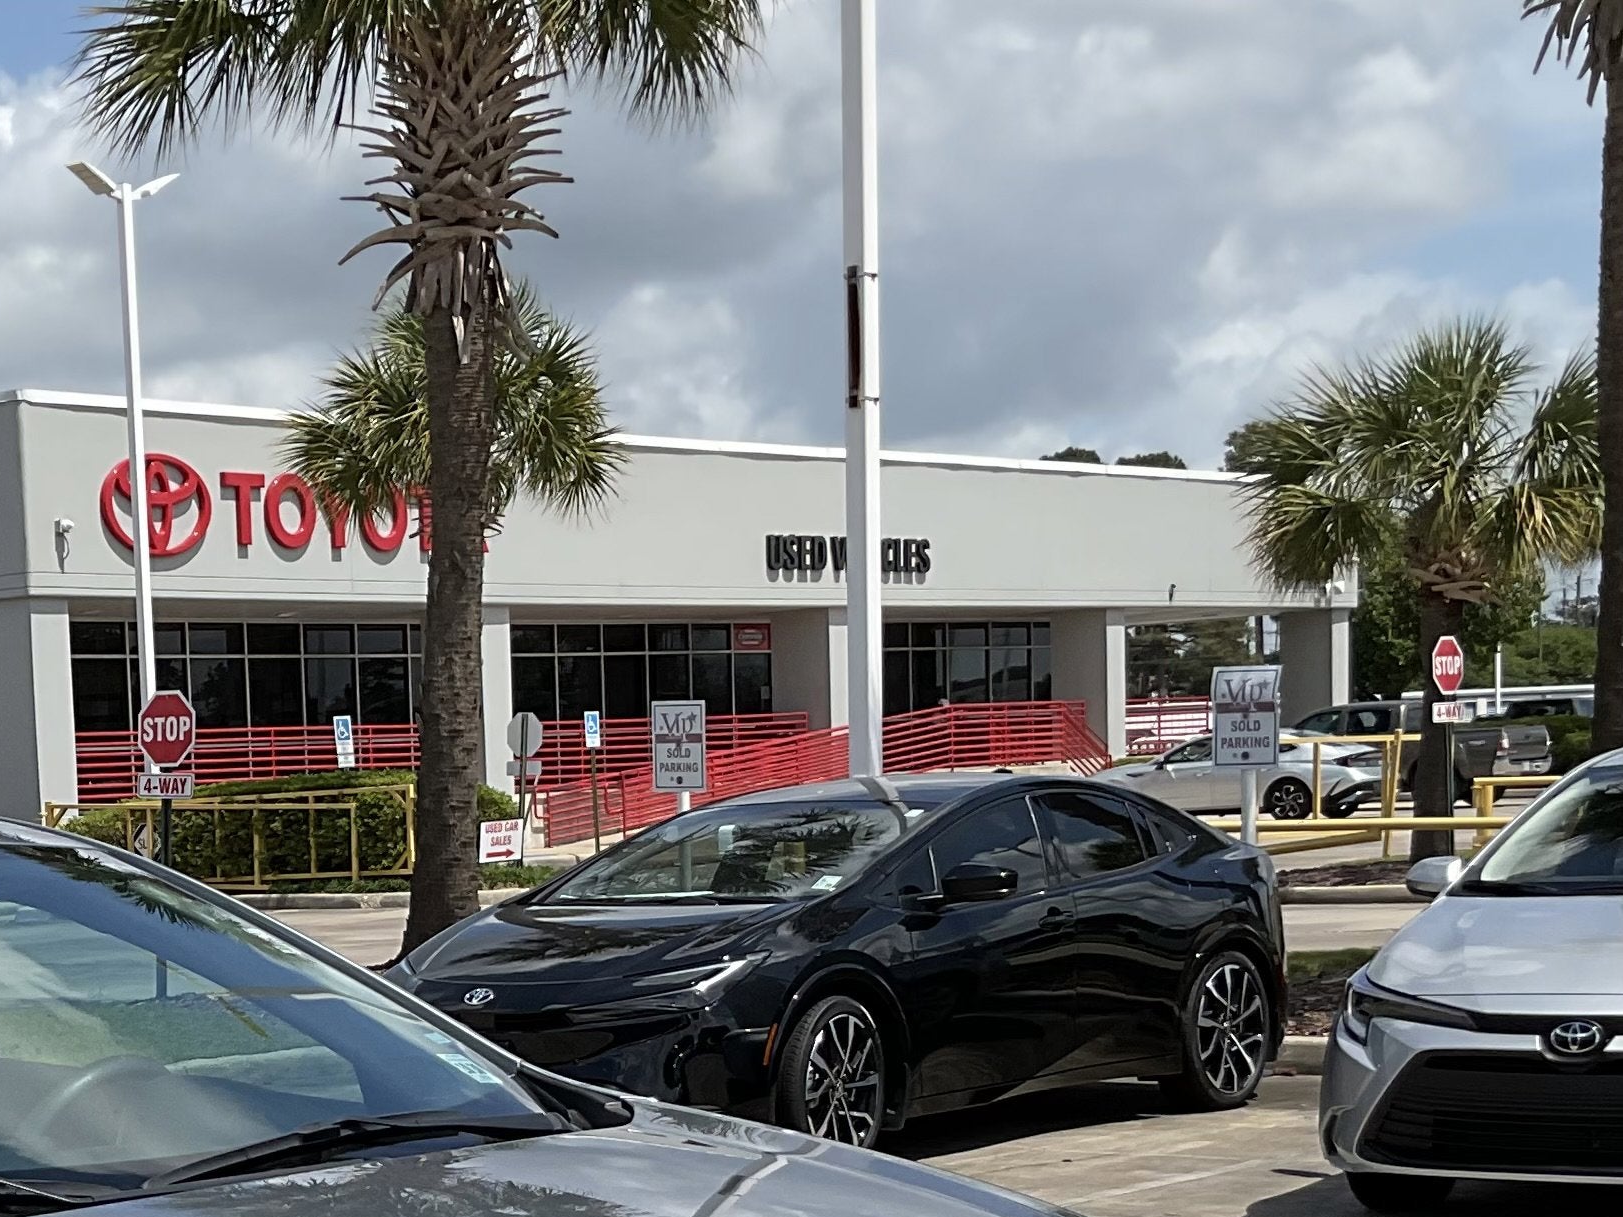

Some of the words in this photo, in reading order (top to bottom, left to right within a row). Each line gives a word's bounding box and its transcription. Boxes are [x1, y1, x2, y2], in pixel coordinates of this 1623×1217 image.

[765, 534, 827, 571] USED
[830, 536, 930, 573] VCLES
[1435, 655, 1460, 676] STOP
[142, 716, 191, 743] STOP
[1231, 719, 1261, 732] SOLD
[1220, 736, 1270, 749] PARKING
[666, 747, 691, 758] SOLD
[659, 762, 699, 773] PARKING
[144, 777, 187, 794] 4-WAY
[485, 823, 502, 833] USED
[505, 821, 519, 831] CAR
[490, 835, 512, 846] SALES
